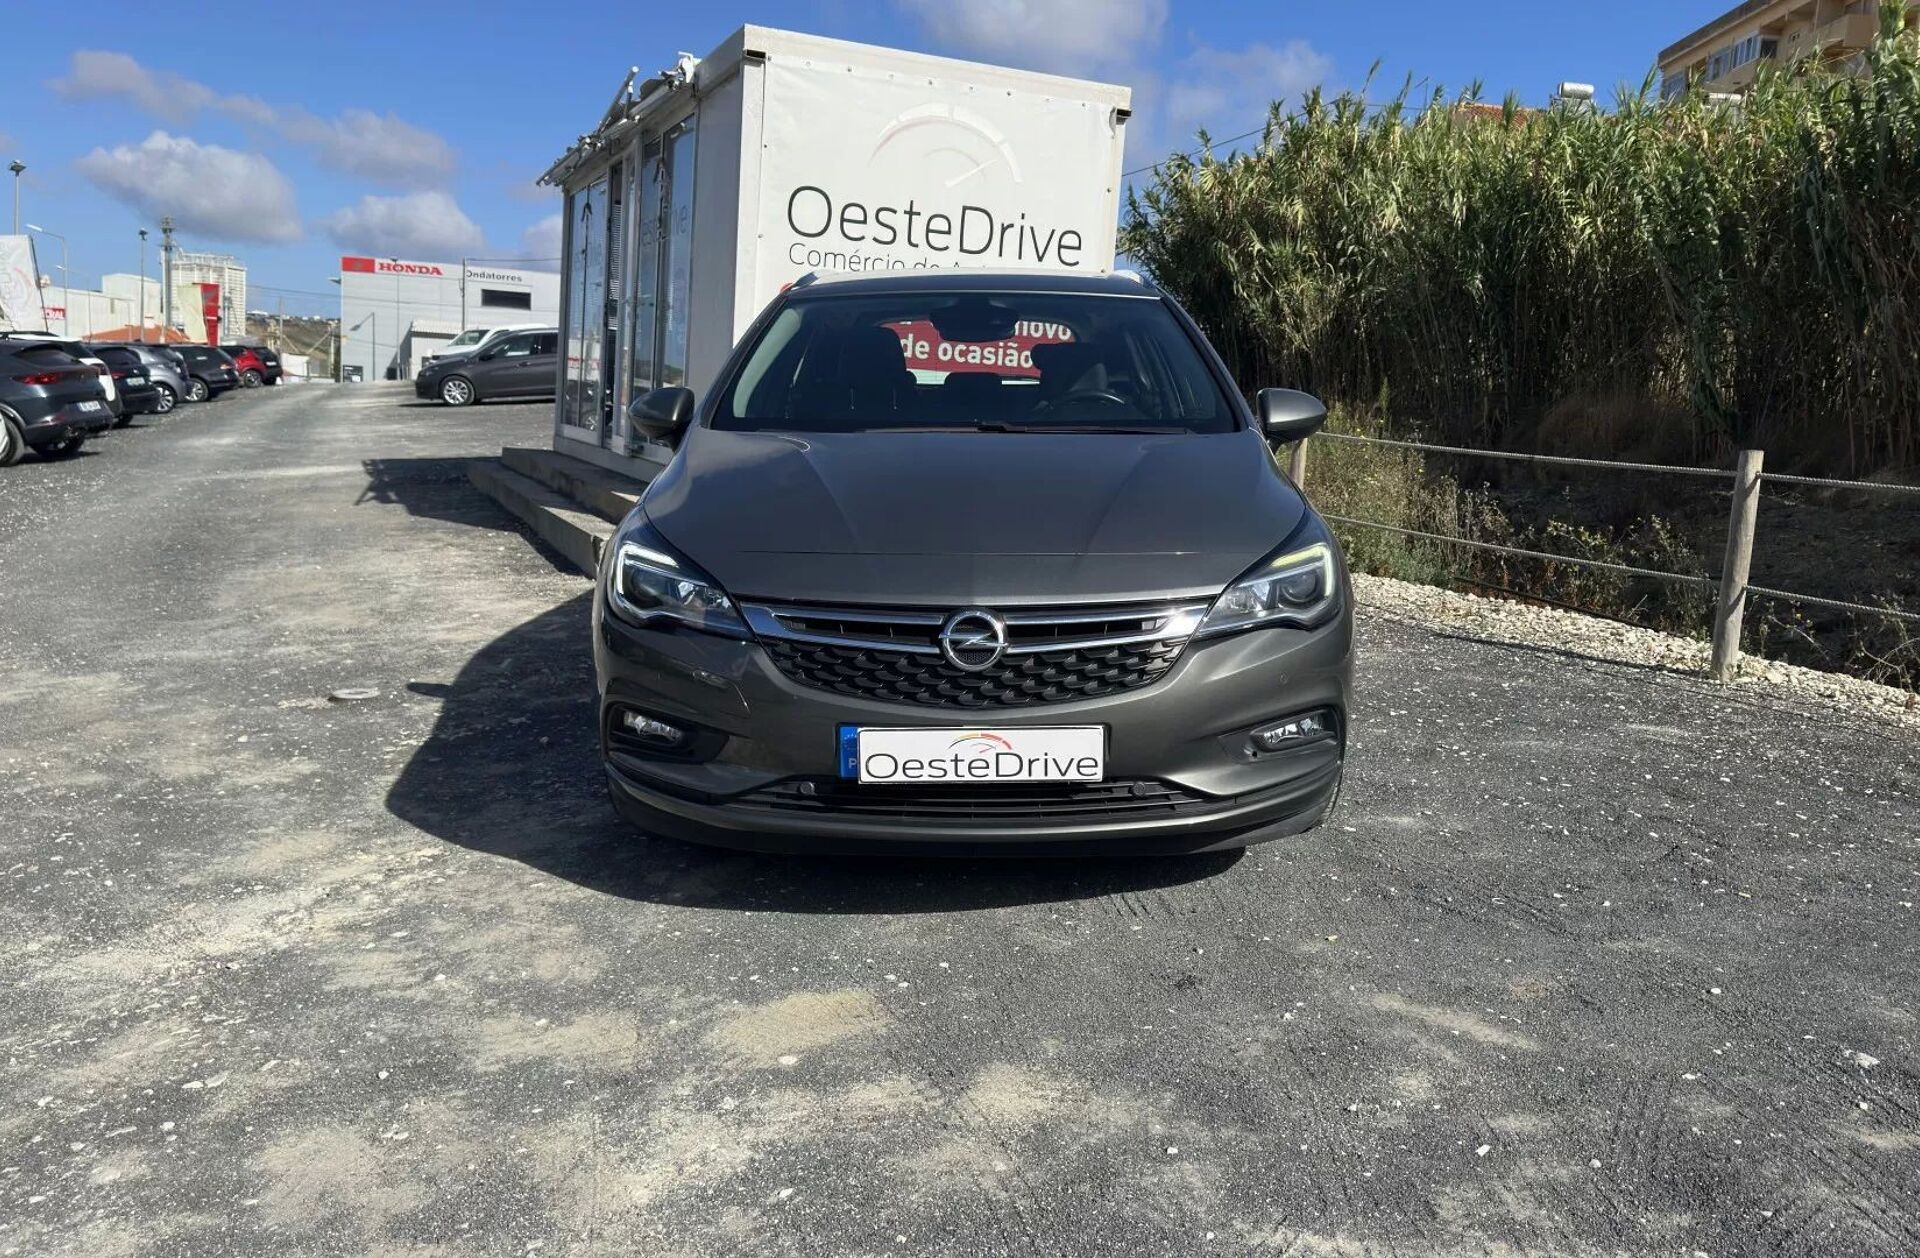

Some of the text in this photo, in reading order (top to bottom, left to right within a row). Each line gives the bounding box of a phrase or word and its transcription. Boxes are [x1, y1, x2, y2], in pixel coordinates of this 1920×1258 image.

[787, 185, 1082, 267] OesteDrive
[378, 262, 443, 276] HONDA
[900, 333, 1033, 368] de ocasião
[865, 752, 1099, 779] OesteDrive
